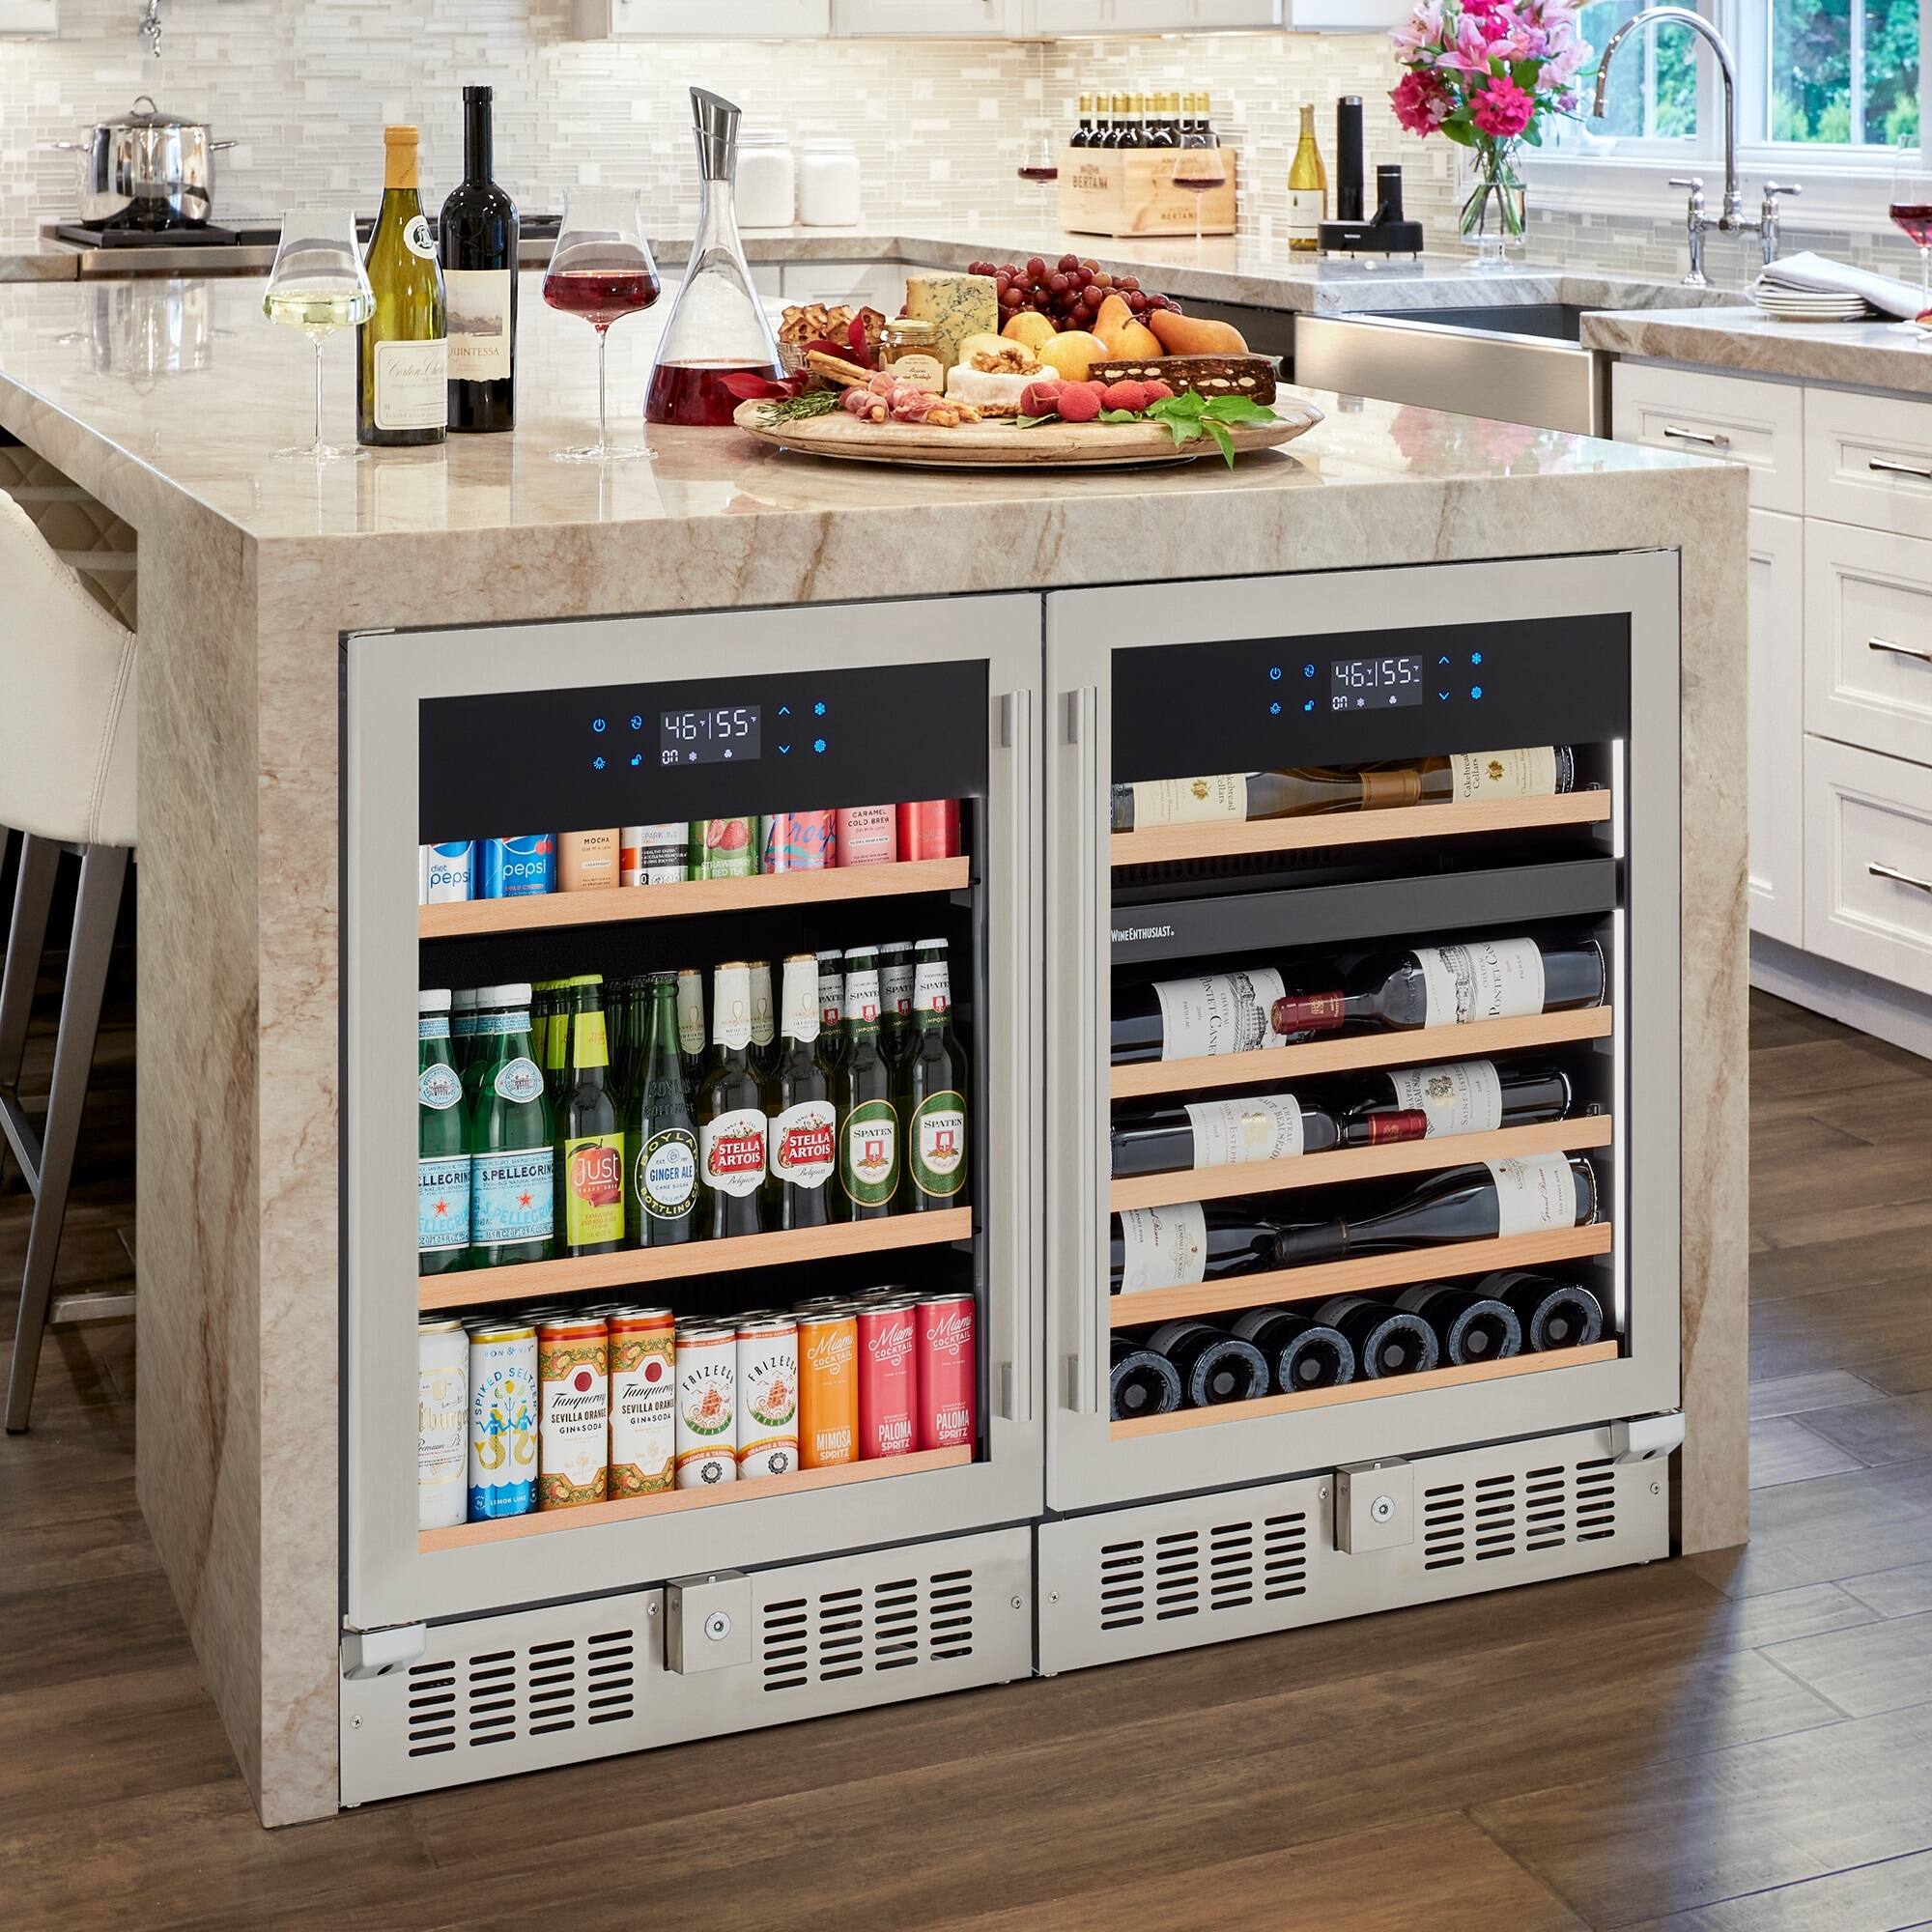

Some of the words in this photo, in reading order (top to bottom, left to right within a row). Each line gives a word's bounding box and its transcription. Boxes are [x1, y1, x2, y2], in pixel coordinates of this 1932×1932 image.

[1472, 758, 1481, 789] Cellars
[848, 818, 868, 828] COLD
[583, 837, 610, 845] MOCHA
[431, 864, 447, 872] diet
[502, 859, 547, 881] pepsi
[701, 859, 751, 870] STRAWBERRY
[712, 868, 727, 877] RED
[431, 867, 471, 889] pepsi
[923, 1119, 962, 1129] SPATEN
[789, 1132, 831, 1147] STELLA
[853, 1127, 893, 1139] SPATEN
[719, 1140, 760, 1154] STELLA
[788, 1144, 831, 1159] ARTOIS
[718, 1151, 761, 1167] ARTOIS
[649, 1168, 680, 1182] GINGER
[681, 1165, 693, 1178] ALE
[926, 1312, 972, 1341] Miami
[868, 1321, 914, 1351] Miami
[932, 1328, 972, 1348] COCKTAIL
[808, 1330, 854, 1360] Miami
[874, 1340, 913, 1359] COCKTAIL
[813, 1349, 853, 1368] COCKTAIL
[474, 1371, 502, 1416] SPIKED
[551, 1412, 582, 1424] SEVILLA
[584, 1407, 607, 1420] ORANGE
[621, 1403, 653, 1414] SEVILLA
[936, 1408, 970, 1431] PALOMA
[878, 1419, 912, 1442] PALOMA
[939, 1427, 968, 1440] SPRITZ
[816, 1429, 852, 1452] MIMOSA
[881, 1437, 910, 1452] SPRITZ
[820, 1447, 850, 1461] SPRITZ
